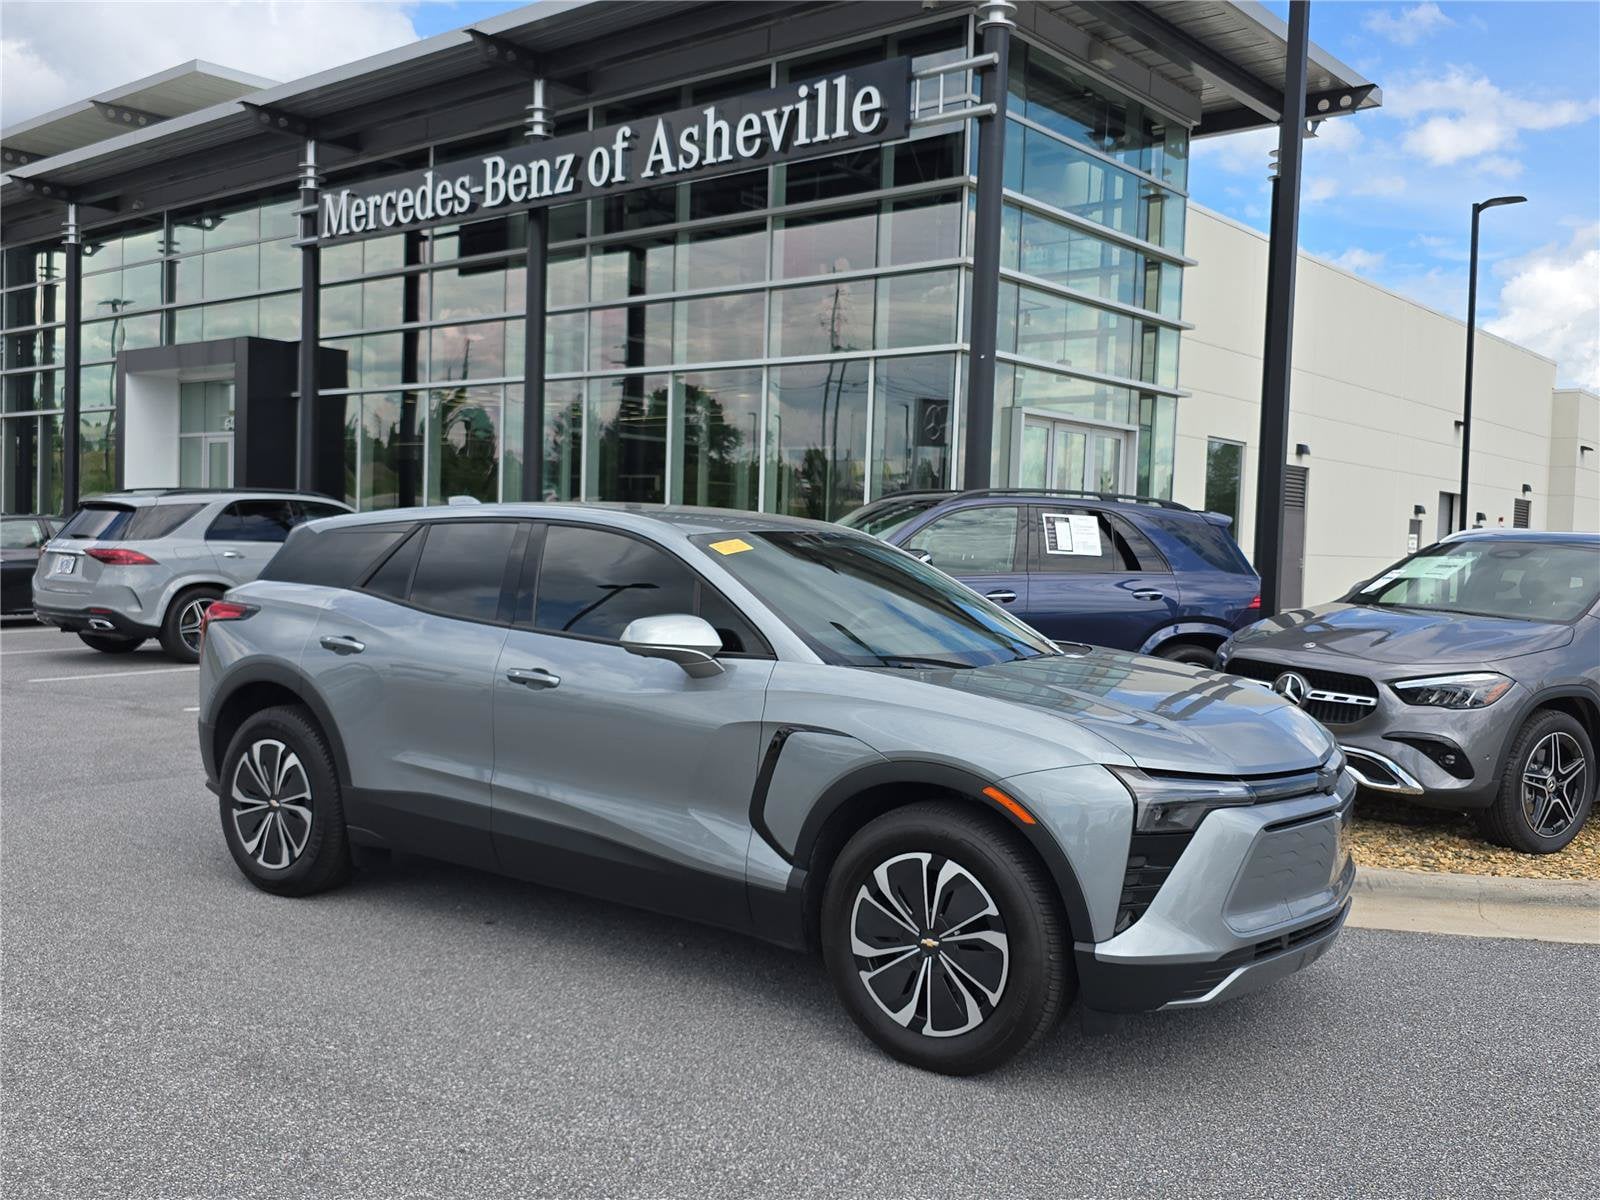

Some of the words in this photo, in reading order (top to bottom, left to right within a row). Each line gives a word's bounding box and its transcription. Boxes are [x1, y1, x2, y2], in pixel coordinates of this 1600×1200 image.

[321, 153, 576, 239] Mercedes-Benz
[587, 126, 632, 187] of
[640, 75, 882, 178] Asheville
